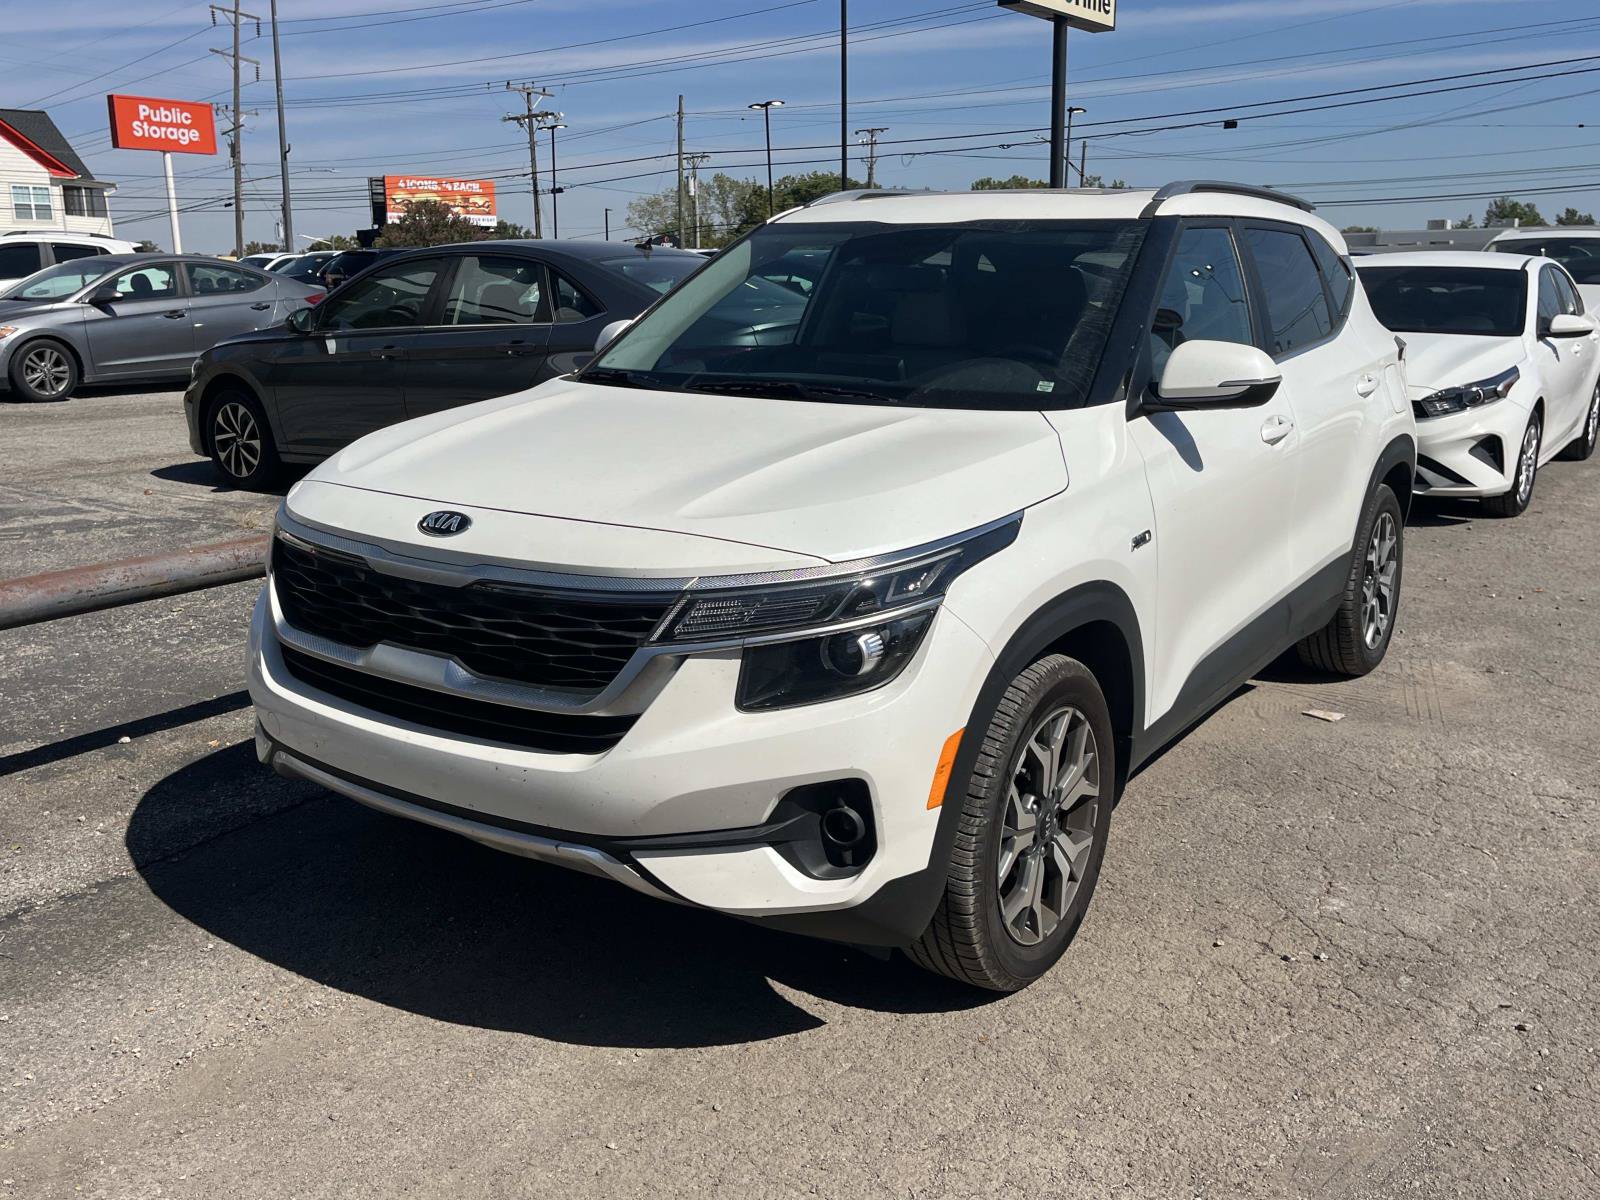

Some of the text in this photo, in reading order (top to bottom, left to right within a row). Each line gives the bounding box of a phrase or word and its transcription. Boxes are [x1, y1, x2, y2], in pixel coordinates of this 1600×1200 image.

[138, 104, 192, 125] Public
[132, 120, 200, 145] Storage
[398, 180, 406, 188] 4
[453, 182, 483, 193] EACH.
[422, 512, 462, 532] KIA
